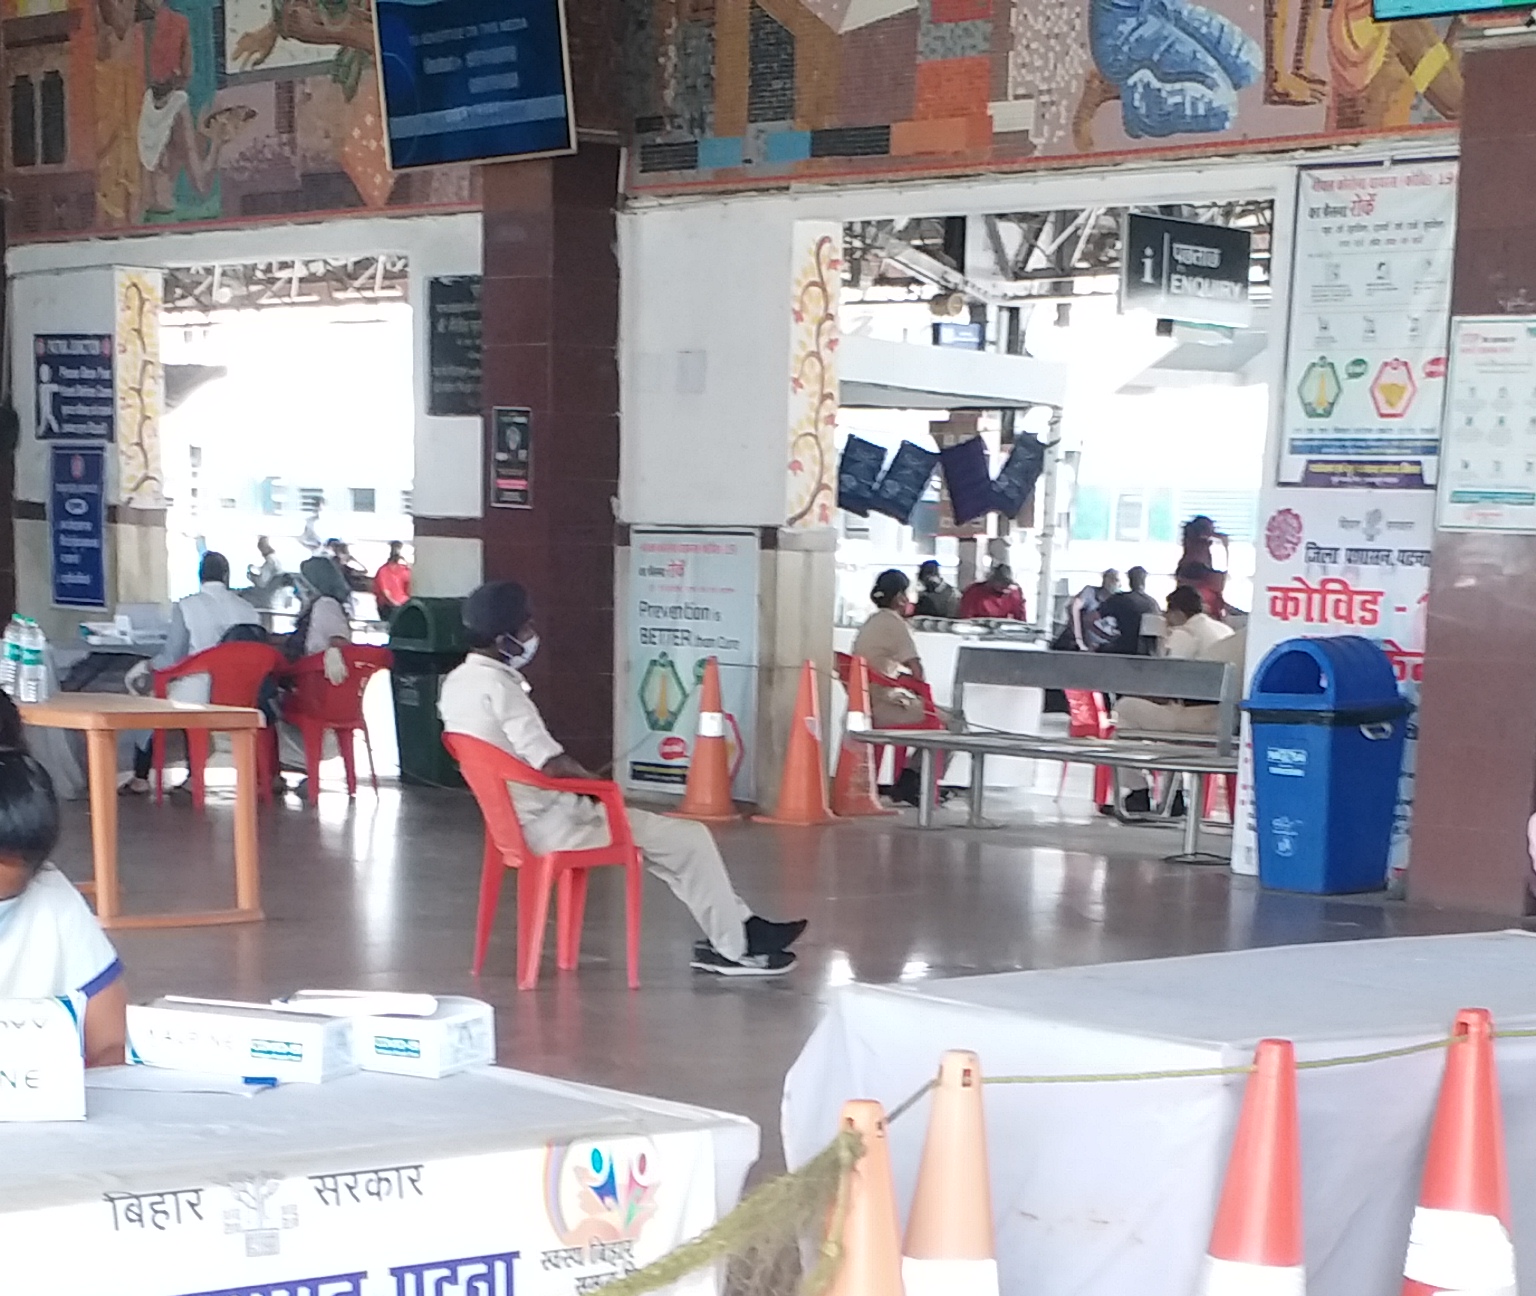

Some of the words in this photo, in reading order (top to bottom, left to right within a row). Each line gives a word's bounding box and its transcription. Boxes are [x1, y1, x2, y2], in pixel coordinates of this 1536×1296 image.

[1169, 273, 1244, 300] ENQUIRY
[1304, 540, 1341, 565] जिला
[638, 600, 711, 622] Prevention
[1265, 576, 1386, 627] कोविड
[638, 627, 693, 648] BETTER
[102, 1186, 204, 1231] बिहार
[307, 1163, 425, 1207] सरकार
